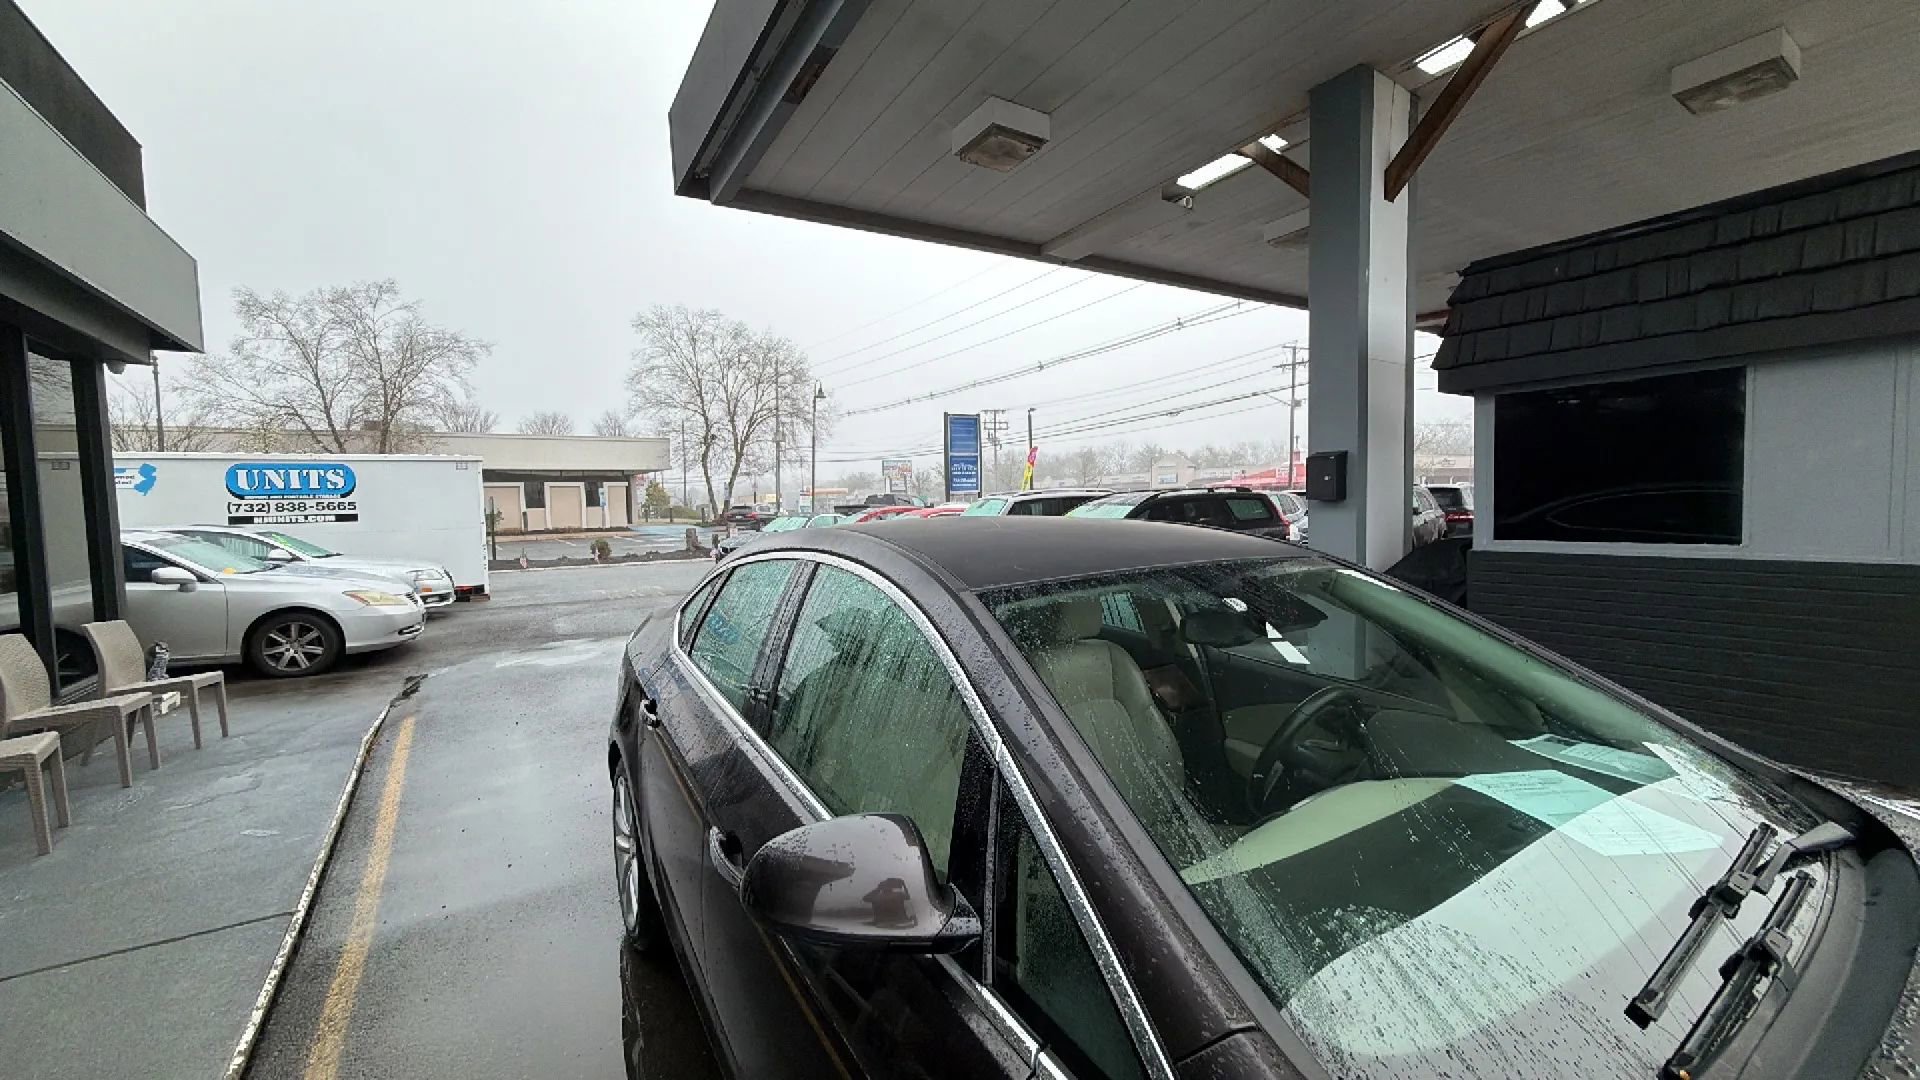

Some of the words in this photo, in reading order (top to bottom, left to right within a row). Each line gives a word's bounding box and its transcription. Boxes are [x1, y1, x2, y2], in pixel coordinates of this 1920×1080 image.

[235, 468, 346, 490] UNITS
[227, 501, 271, 514] (732)
[274, 501, 357, 513] 838-5665
